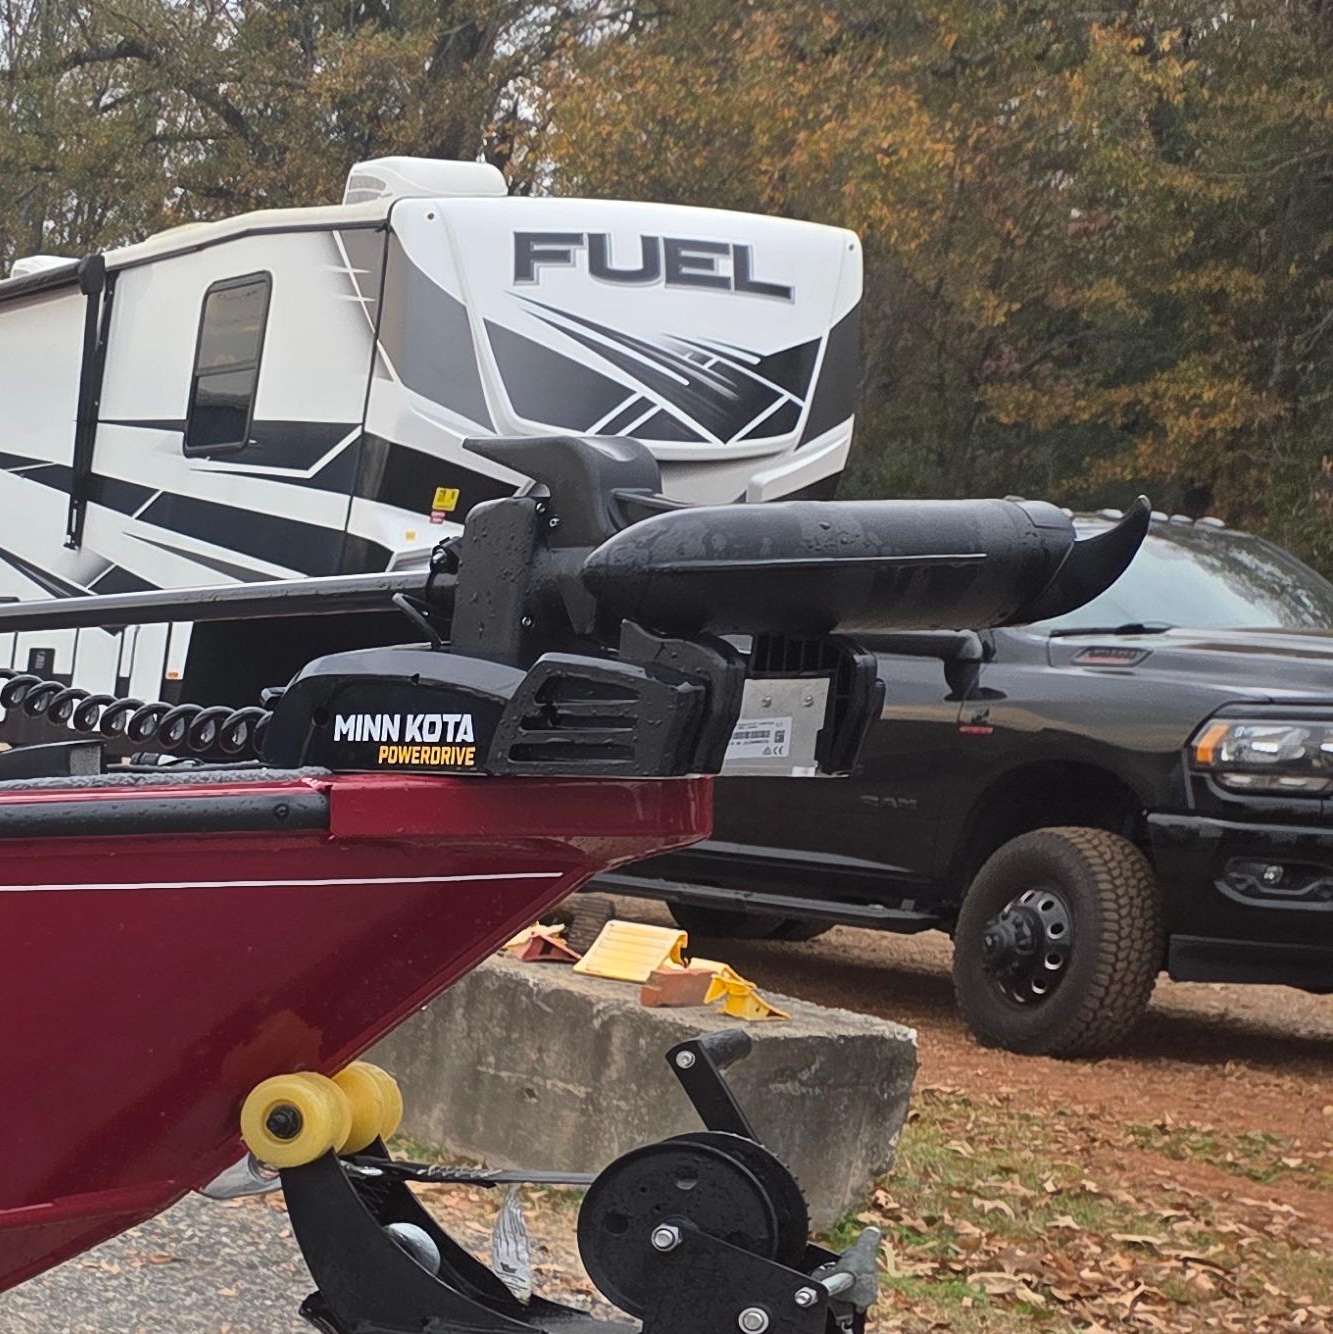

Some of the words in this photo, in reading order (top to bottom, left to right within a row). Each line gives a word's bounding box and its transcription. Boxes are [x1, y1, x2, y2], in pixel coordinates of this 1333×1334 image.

[513, 231, 795, 305] FUEL
[333, 714, 401, 742] MINN
[404, 714, 475, 743] KOTA
[378, 745, 476, 766] POWERDRIVE
